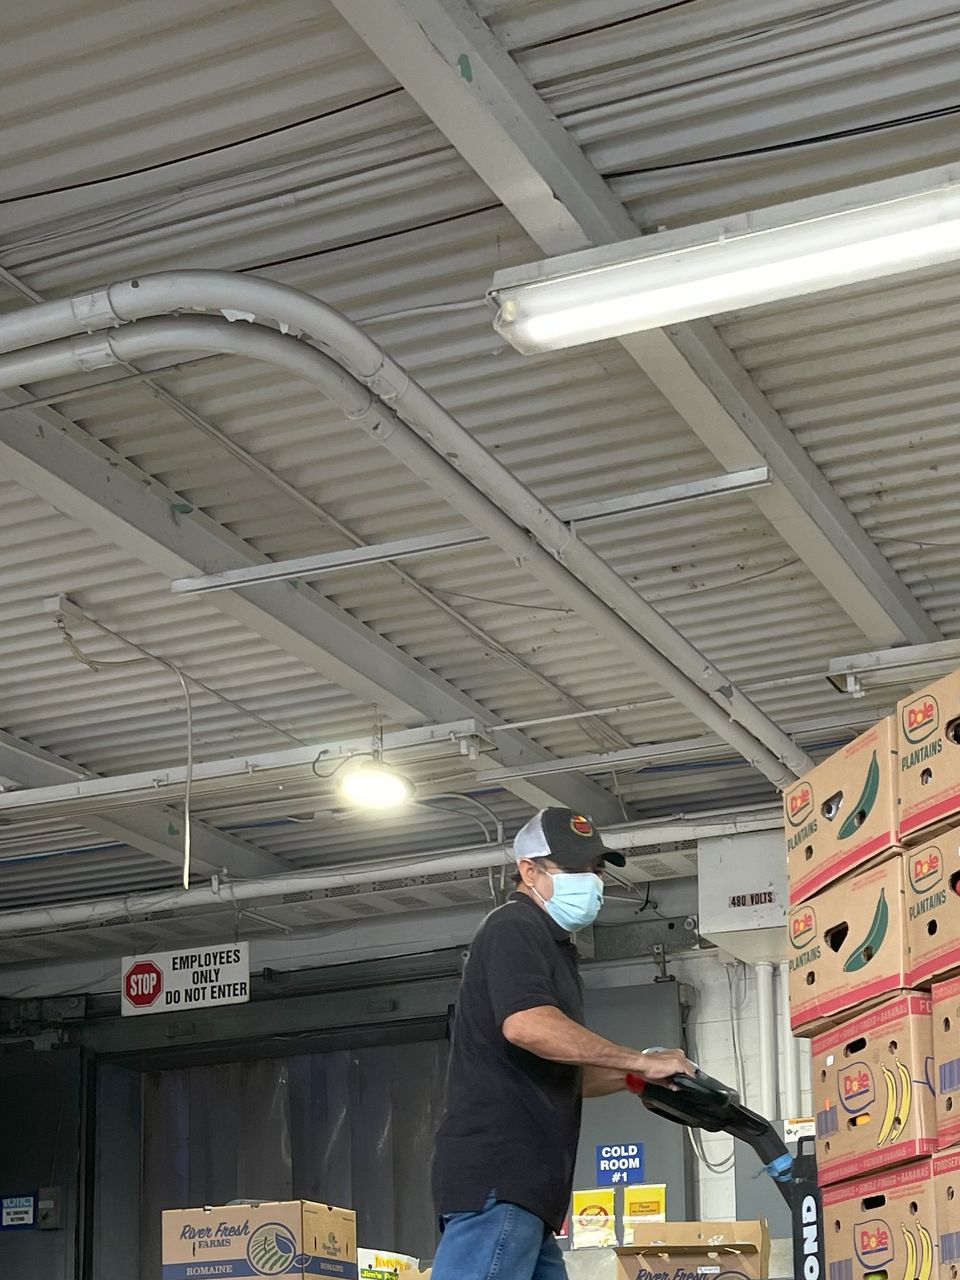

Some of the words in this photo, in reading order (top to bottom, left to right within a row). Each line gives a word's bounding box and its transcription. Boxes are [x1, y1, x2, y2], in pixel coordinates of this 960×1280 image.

[907, 702, 934, 727] Dole
[901, 738, 943, 771] PLANTAINS
[789, 788, 810, 811] Dole
[787, 819, 818, 853] PLANTAINS
[914, 853, 939, 877] Dole
[731, 896, 746, 907] 480
[751, 891, 773, 905] VOLTS
[909, 890, 947, 920] PLANTAINS
[793, 914, 812, 936] Dole
[172, 949, 241, 971] EMPLOYEES
[789, 944, 821, 972] PLANTAINS
[130, 972, 158, 996] STOP
[192, 968, 221, 985] ONLY
[165, 990, 180, 1005] DO
[184, 987, 207, 1003] NOT
[211, 982, 247, 1000] ENTER
[845, 1072, 870, 1094] Dole
[602, 1145, 638, 1157] COLD
[600, 1158, 640, 1171] ROOM
[611, 1172, 628, 1182] #1
[180, 1224, 212, 1241] River
[216, 1219, 250, 1239] Fresh
[861, 1229, 889, 1253] Dole
[198, 1239, 231, 1250] FARMS
[187, 1265, 232, 1276] ROMAINE
